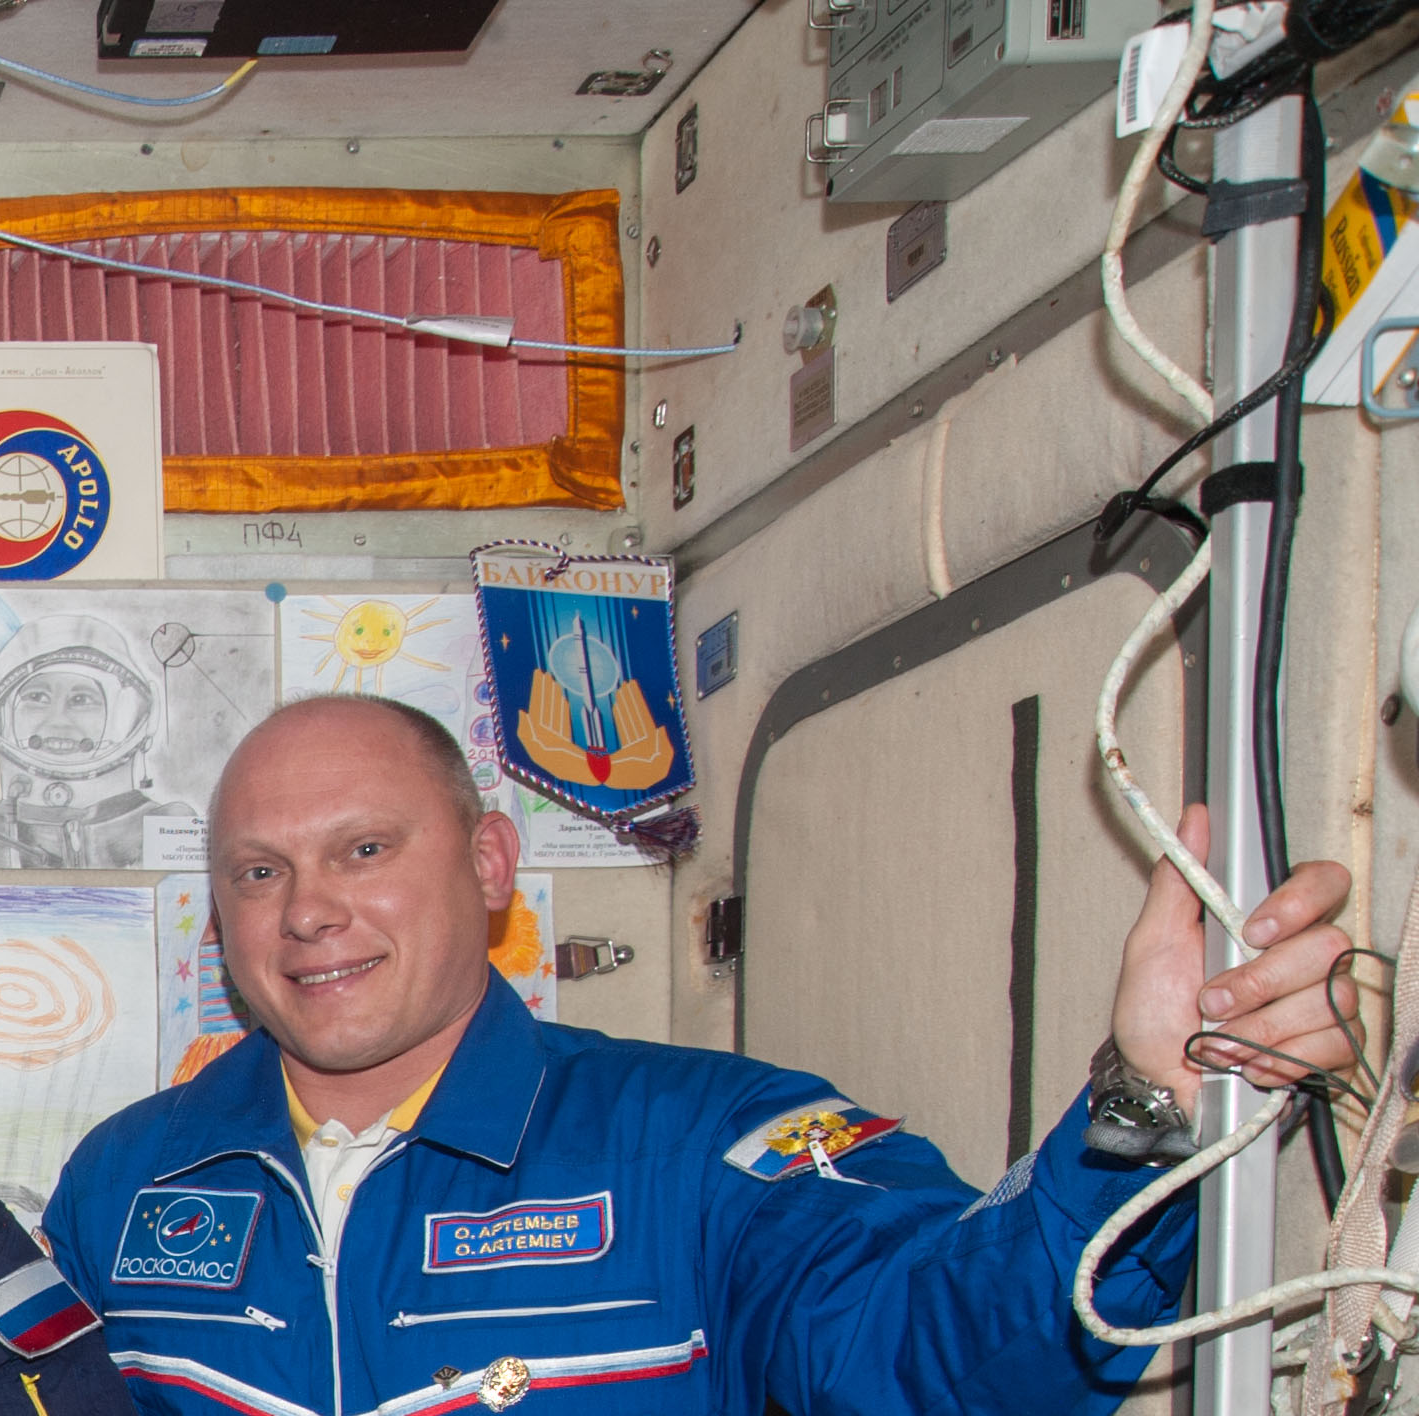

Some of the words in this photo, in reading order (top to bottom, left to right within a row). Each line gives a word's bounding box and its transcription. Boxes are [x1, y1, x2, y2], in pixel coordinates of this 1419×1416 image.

[1330, 216, 1361, 299] Russian
[58, 444, 98, 550] APOLLO
[482, 561, 667, 597] БАЙКОНУР
[479, 1214, 580, 1240] АРТЕМЬЕВ
[479, 1232, 578, 1254] ARTEMIEV
[119, 1256, 234, 1281] РОСКОСМОС
